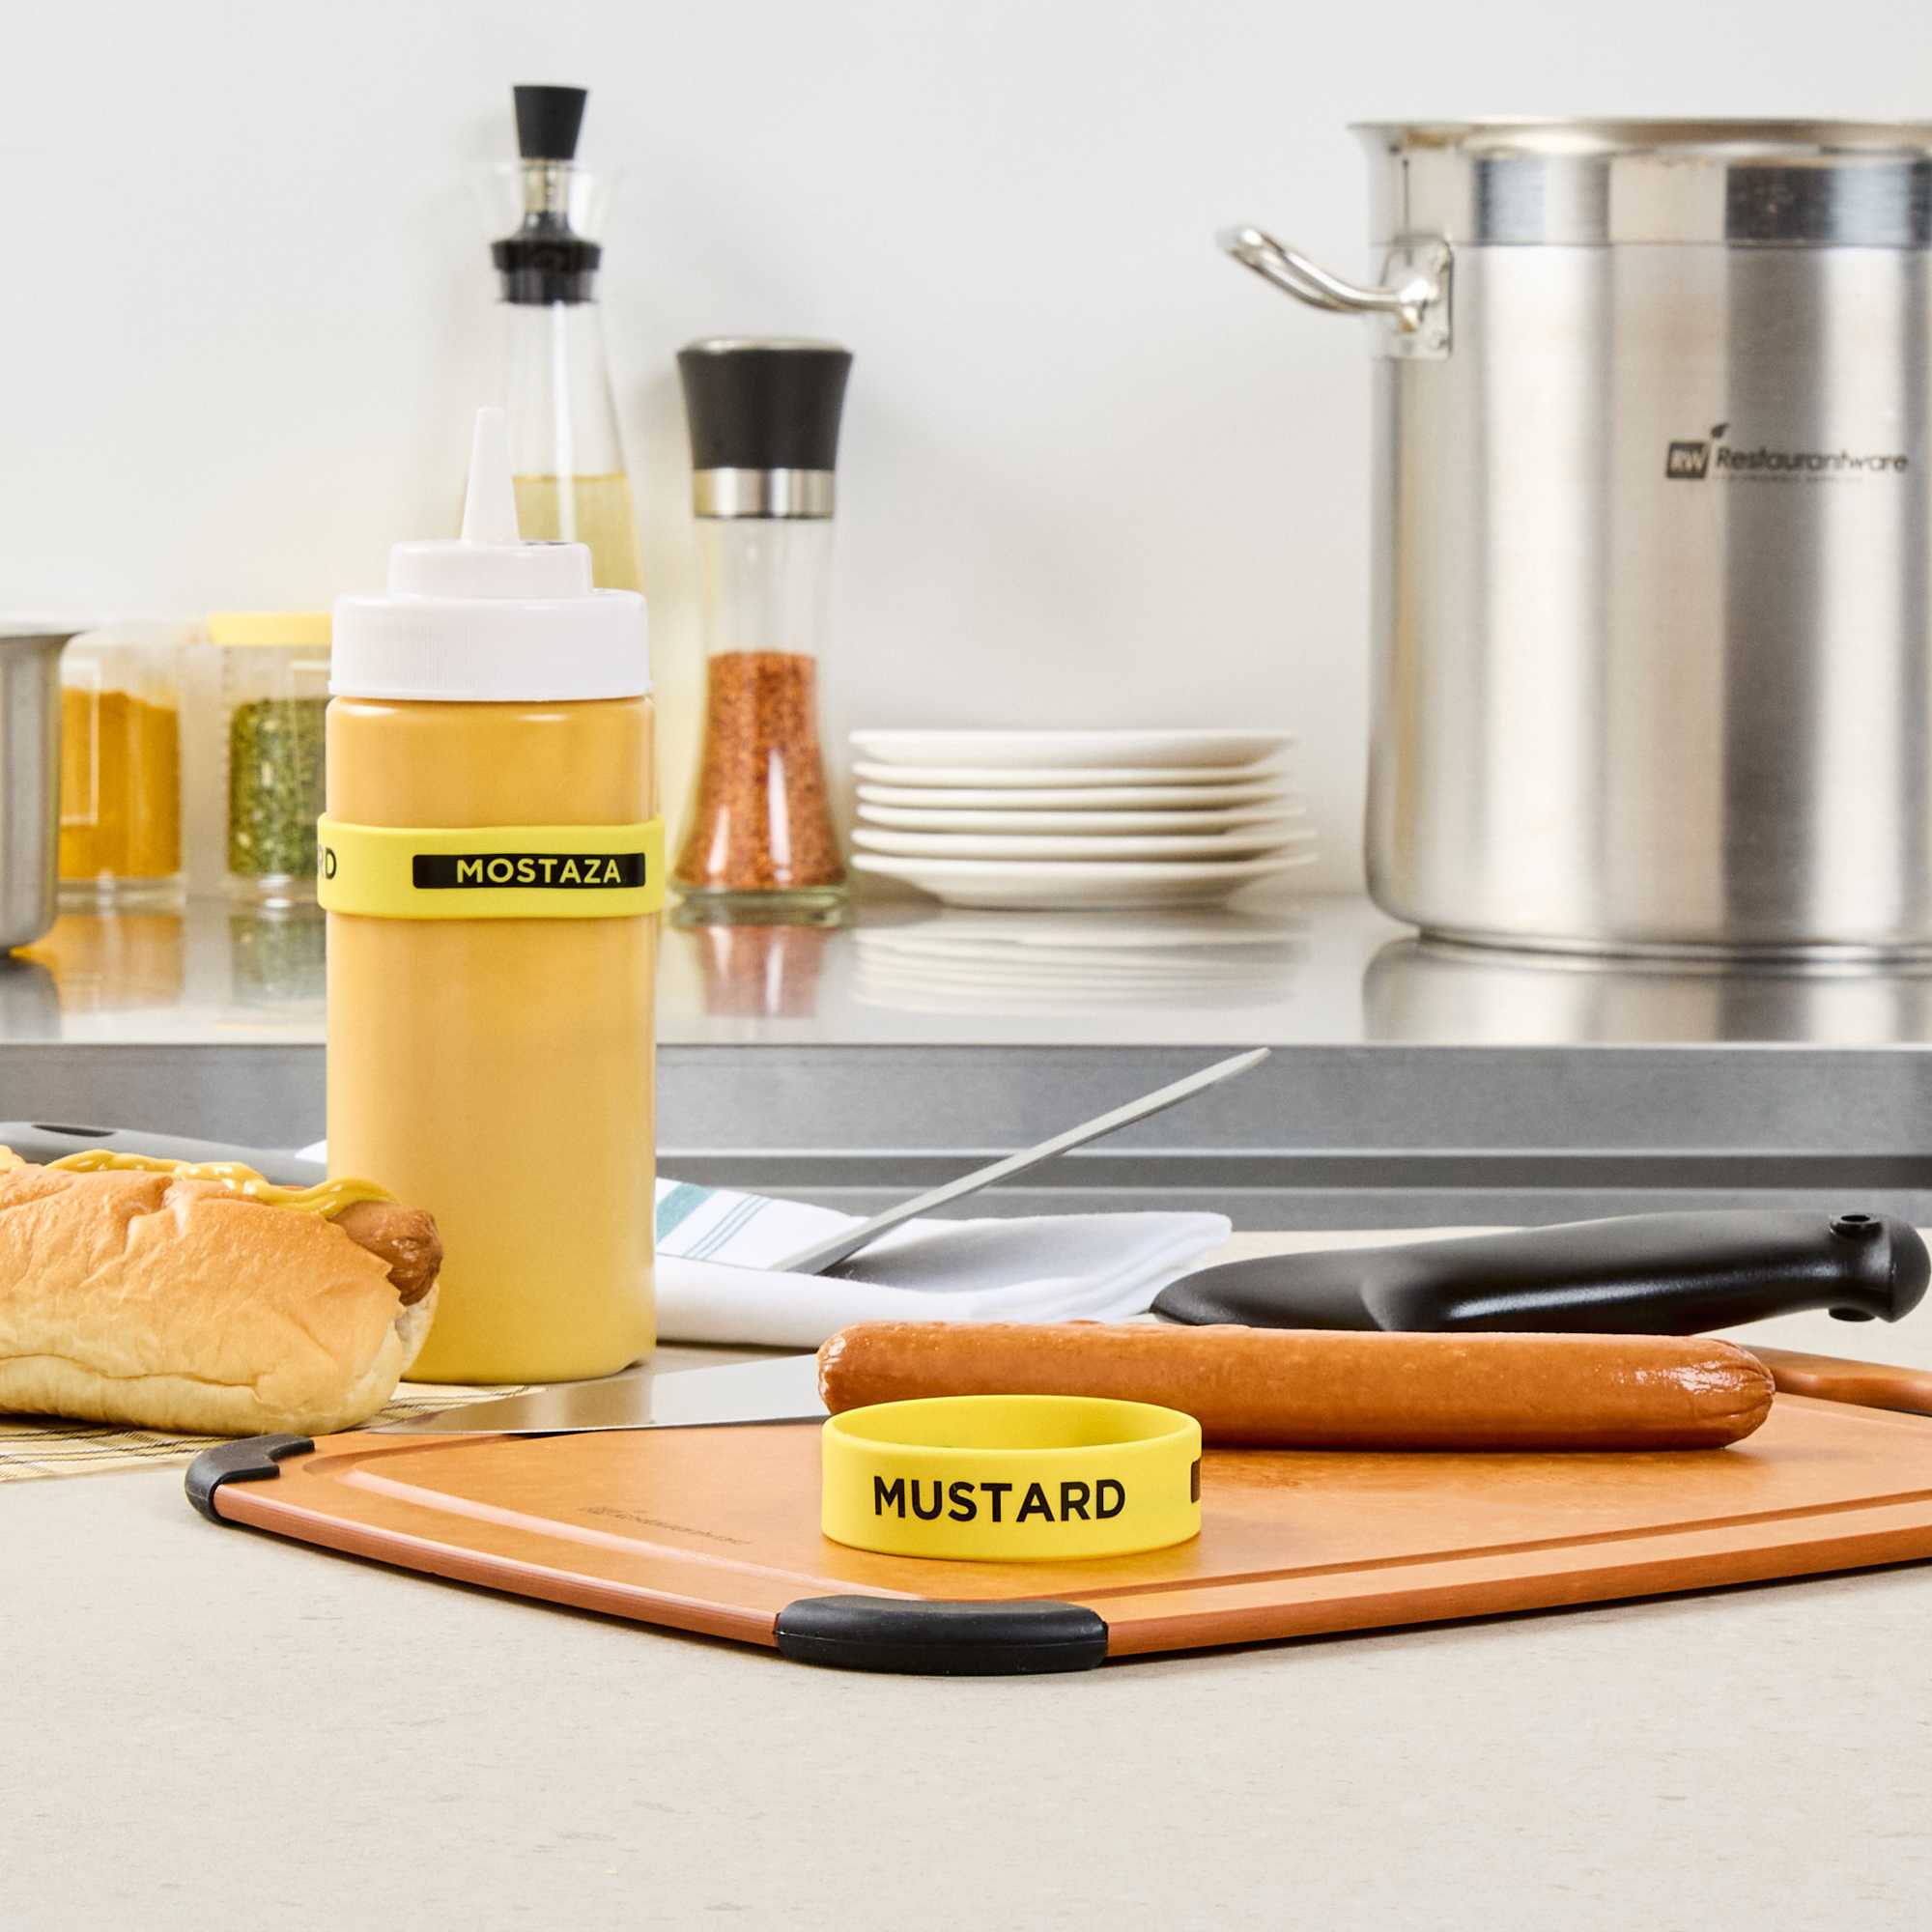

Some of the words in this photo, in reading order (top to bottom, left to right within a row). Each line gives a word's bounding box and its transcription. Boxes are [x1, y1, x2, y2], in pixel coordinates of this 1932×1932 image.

[1717, 446, 1908, 472] Restaurantware
[456, 858, 622, 884] MOSTAZA
[873, 1475, 1126, 1522] MUSTARD
